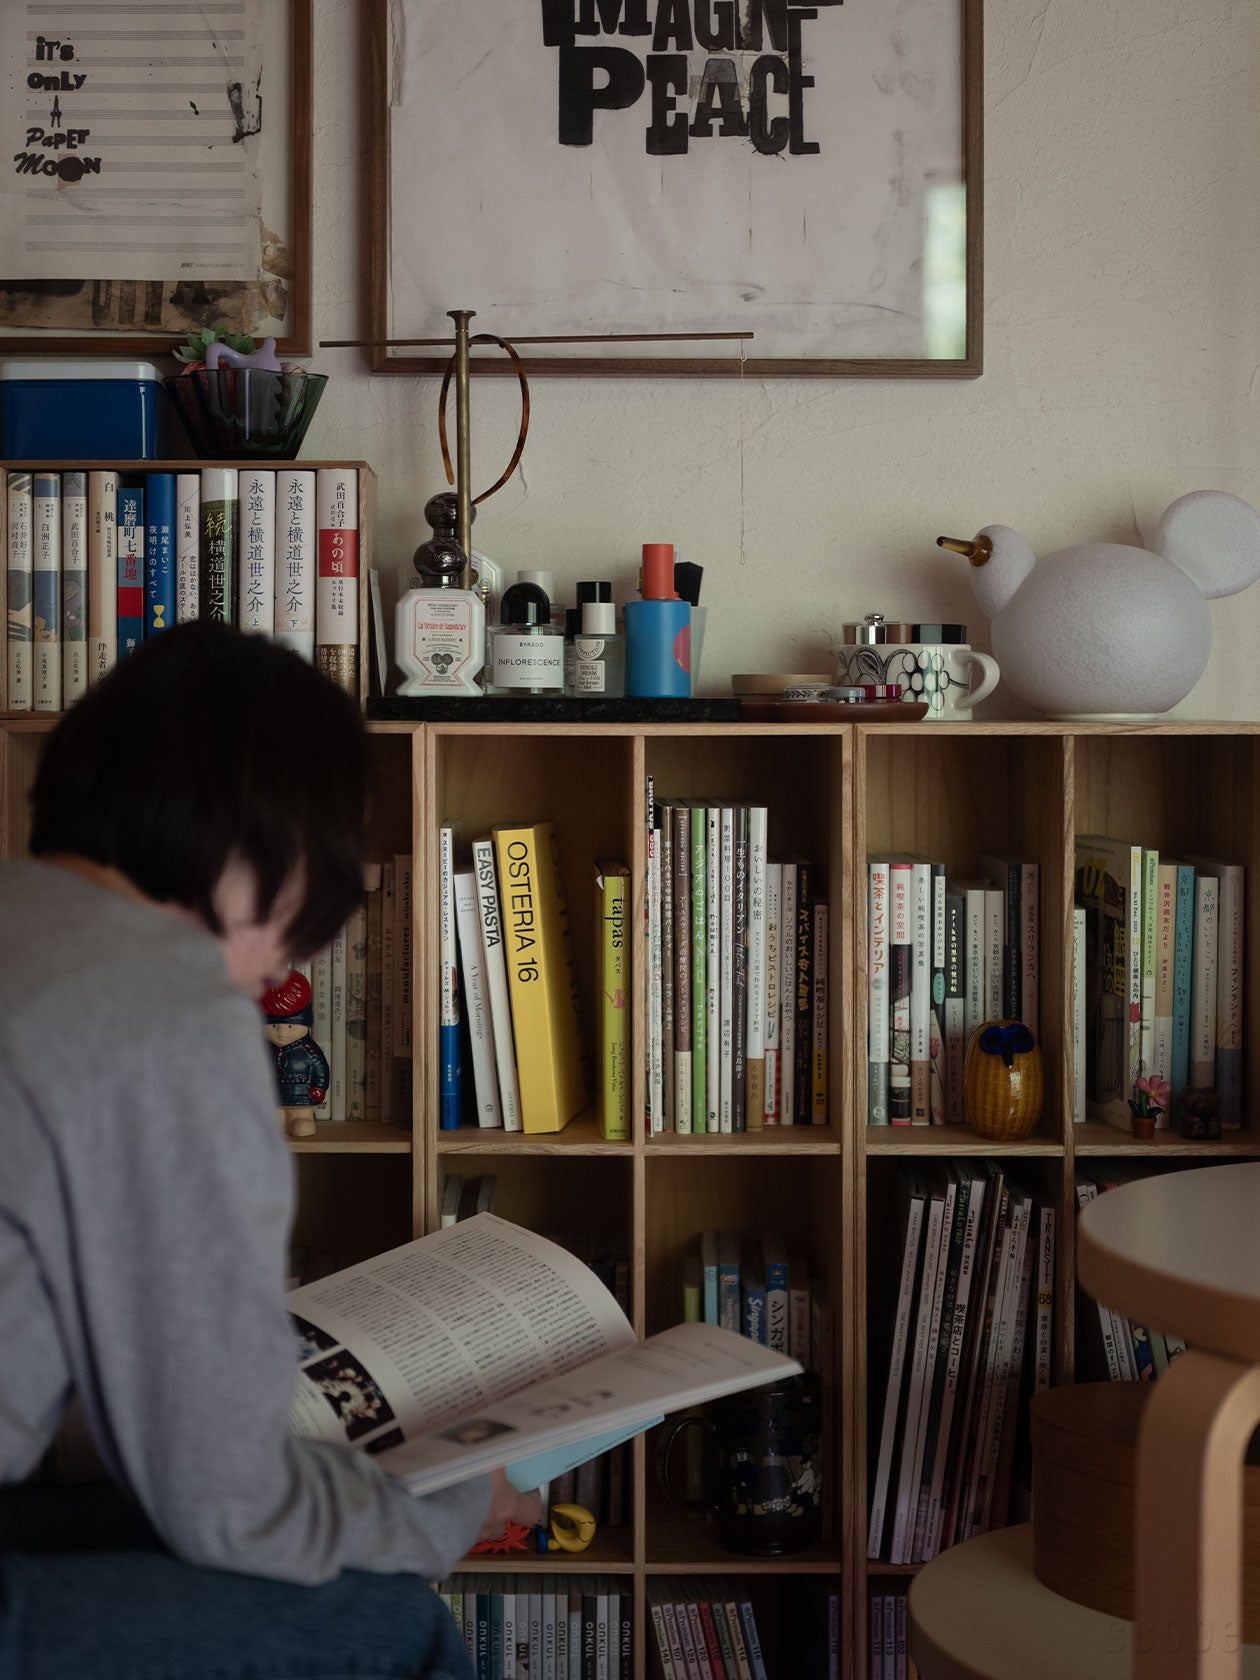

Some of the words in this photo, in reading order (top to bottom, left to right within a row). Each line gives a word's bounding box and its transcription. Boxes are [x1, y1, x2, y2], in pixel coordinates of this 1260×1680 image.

[559, 9, 821, 155] PEACE
[50, 95, 62, 127] A
[204, 511, 233, 539] 続
[336, 482, 346, 528] 武田百合子
[41, 523, 50, 560] 白洲正子
[70, 522, 79, 564] 武田百合子
[123, 499, 137, 581] 達磨町七番地
[149, 525, 158, 599] 夜明けのすべて
[160, 525, 169, 574] 瀬尾まいこ
[248, 479, 264, 613] 永遠と横道世之介
[286, 479, 304, 613] 永遠と横道世之介
[332, 533, 344, 574] あの頃
[252, 618, 260, 627] 上
[290, 619, 299, 628] 下
[498, 658, 561, 667] INFLORESCENCE
[477, 847, 495, 891] EASY
[695, 844, 704, 940] アジアのごはん
[753, 844, 762, 920] おいしいの秘密
[482, 895, 500, 948] PASTA
[507, 841, 535, 952] OSTERIA
[604, 898, 625, 949] tapas
[872, 872, 885, 975] 喫茶とインテリア
[896, 883, 905, 940] 純喫茶の空間
[917, 877, 925, 968] 美しい純喫茶の写真集
[1163, 883, 1171, 950] 軽井沢週末だより
[518, 959, 539, 983] 16
[768, 923, 777, 1019] おうちビストロレシピ
[1027, 926, 1036, 980] スリランカへ
[1044, 1212, 1052, 1284] TRANSIT
